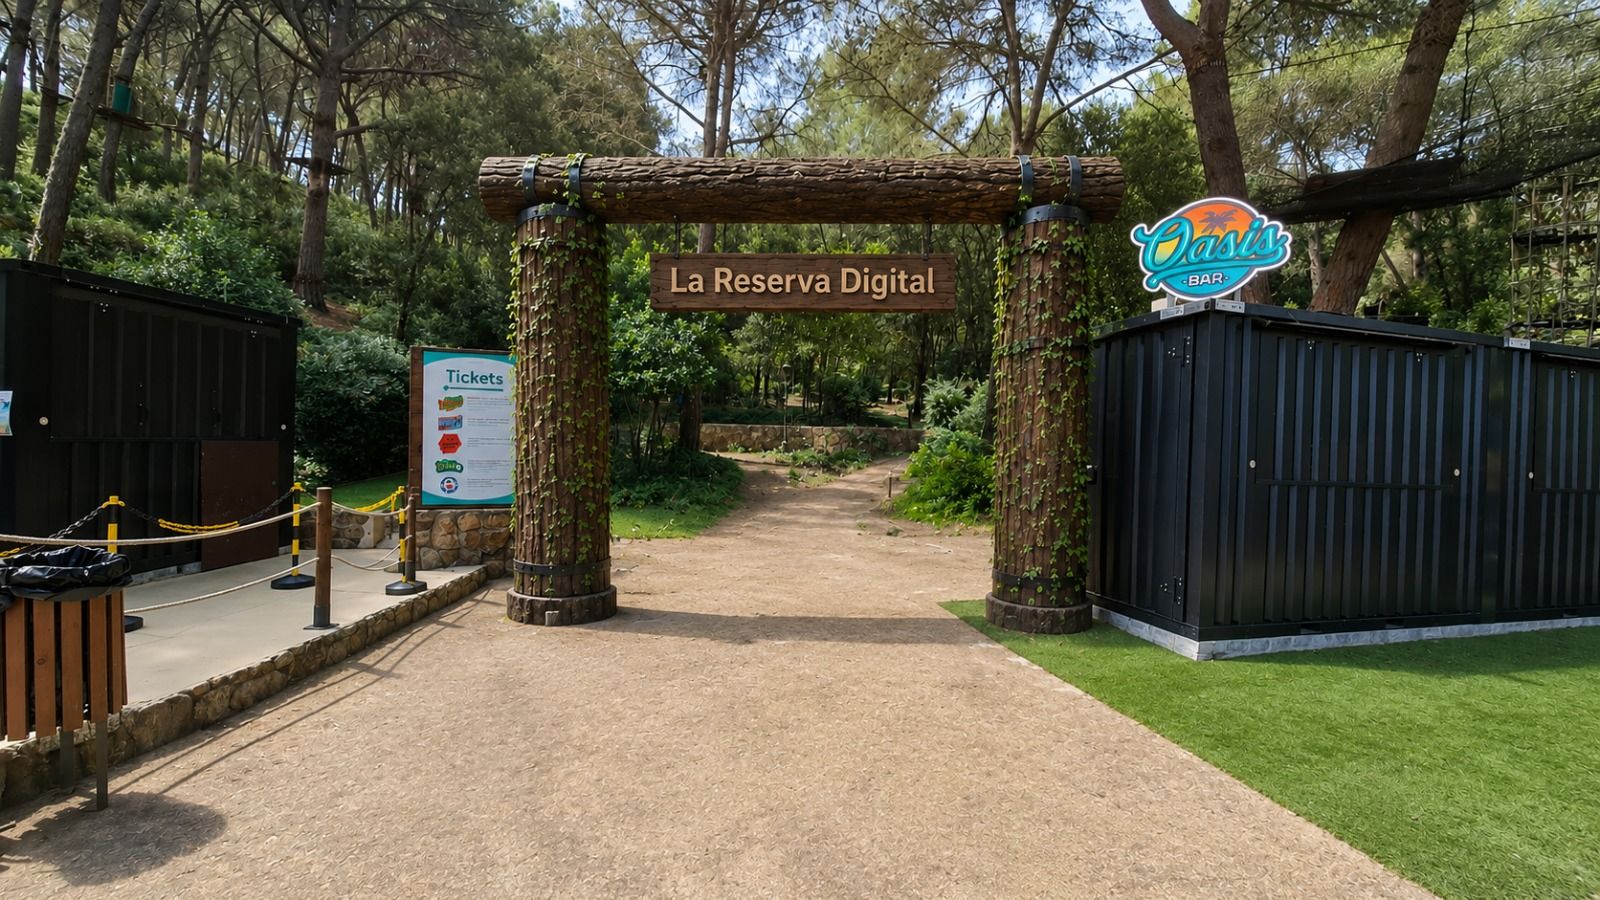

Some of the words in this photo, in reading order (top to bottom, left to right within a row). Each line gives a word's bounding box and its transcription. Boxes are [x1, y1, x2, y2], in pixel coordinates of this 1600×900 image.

[1133, 216, 1290, 275] Oasis
[671, 266, 704, 293] La
[714, 266, 831, 294] Reserva
[841, 266, 935, 300] Digital
[1188, 272, 1224, 287] BAR
[446, 369, 504, 385] Tickets
